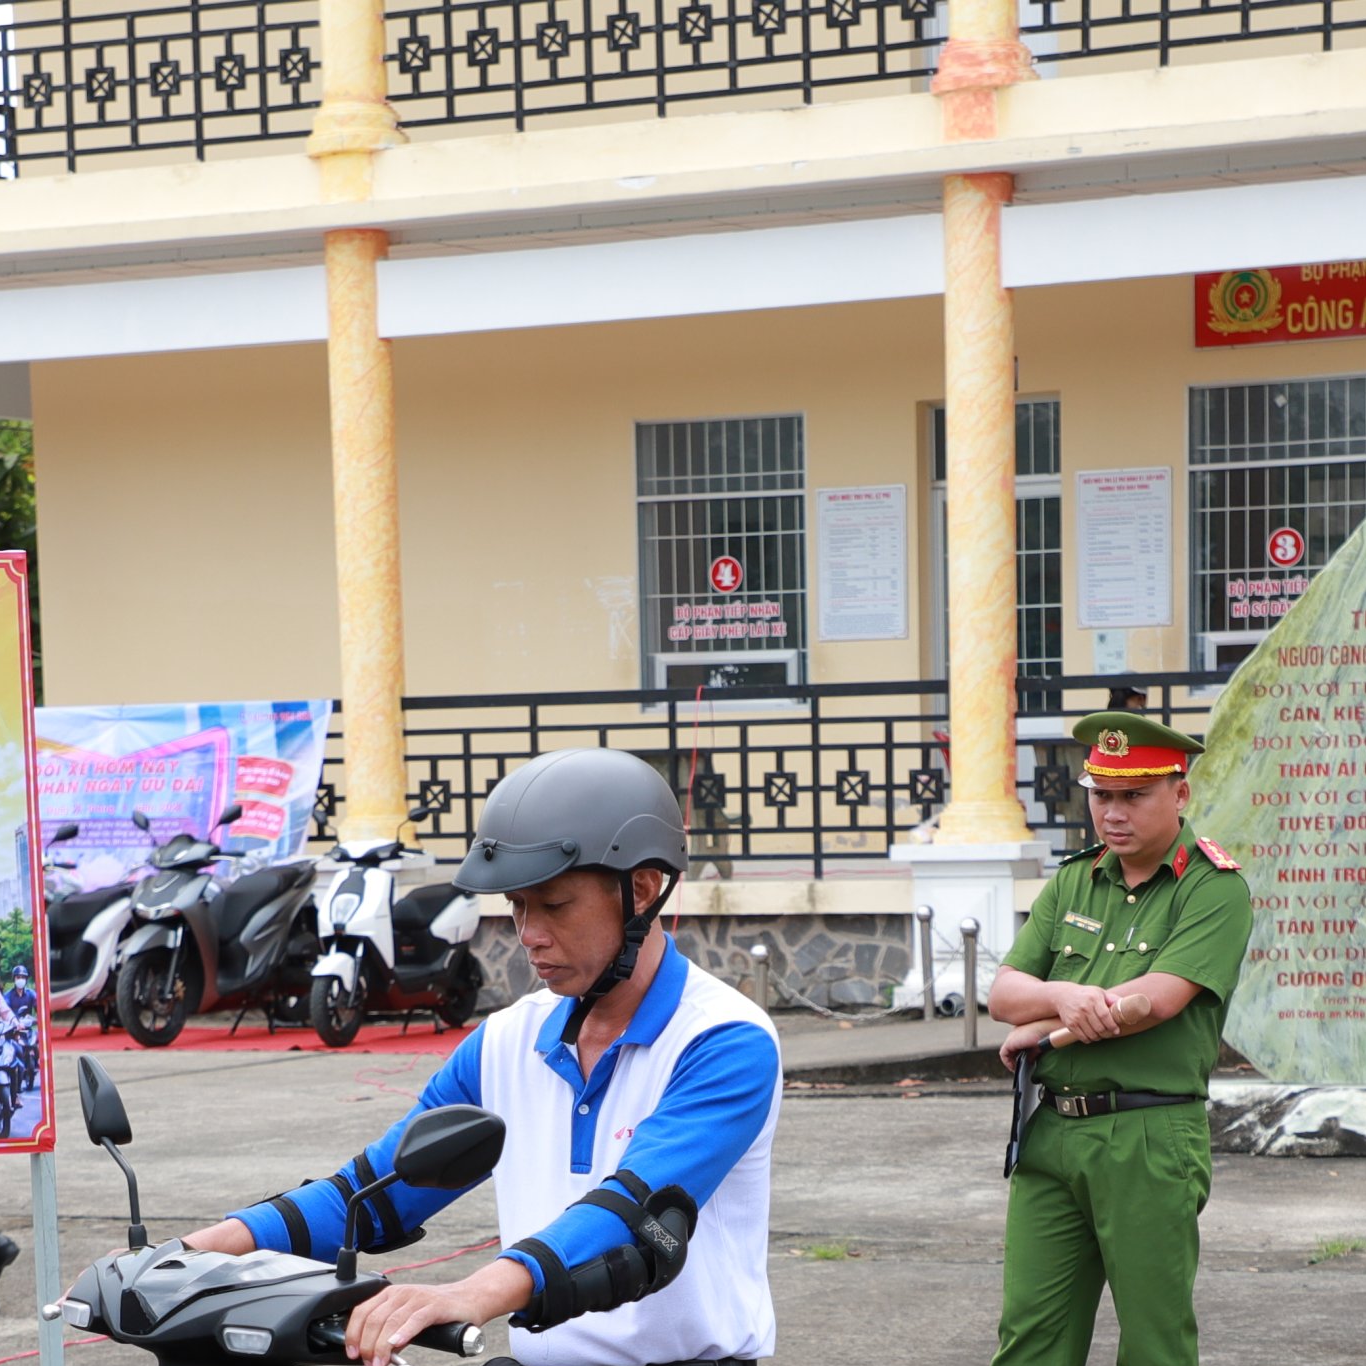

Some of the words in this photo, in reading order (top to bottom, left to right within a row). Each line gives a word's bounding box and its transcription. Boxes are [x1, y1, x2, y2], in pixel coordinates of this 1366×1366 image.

[1286, 297, 1355, 334] CÔNG
[1275, 533, 1296, 560] 3
[716, 562, 736, 587] 4
